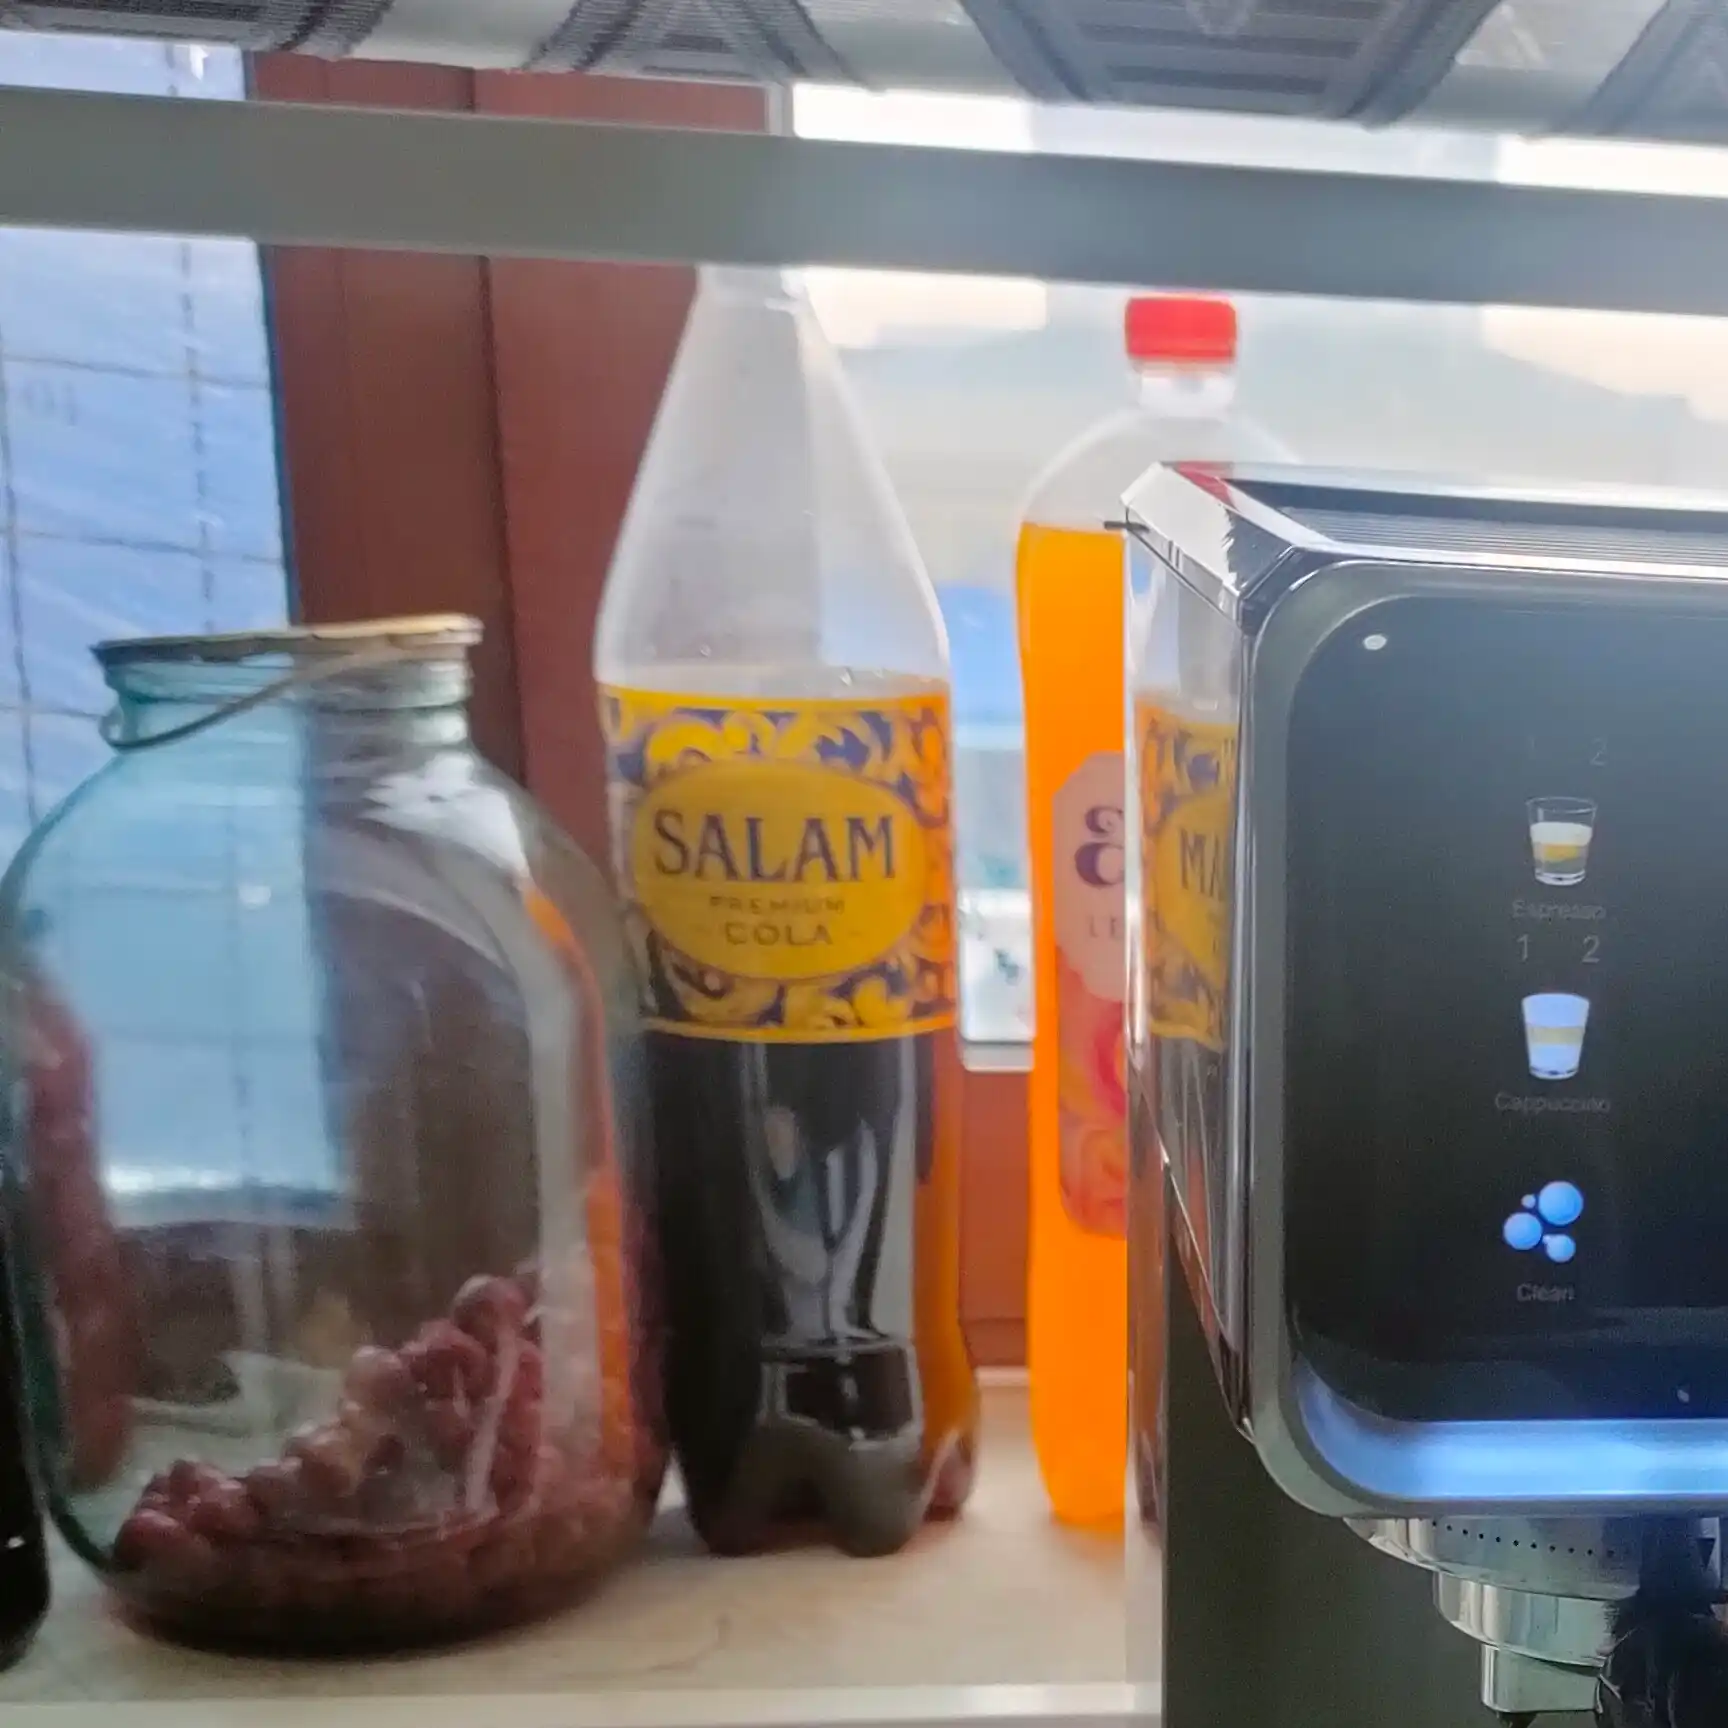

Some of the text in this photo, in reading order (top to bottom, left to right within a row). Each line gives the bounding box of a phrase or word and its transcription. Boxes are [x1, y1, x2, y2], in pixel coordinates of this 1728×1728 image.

[653, 808, 896, 882] SALAM
[723, 921, 834, 947] COLA
[1516, 934, 1600, 963] 1 2
[1517, 1283, 1575, 1301] Clean
